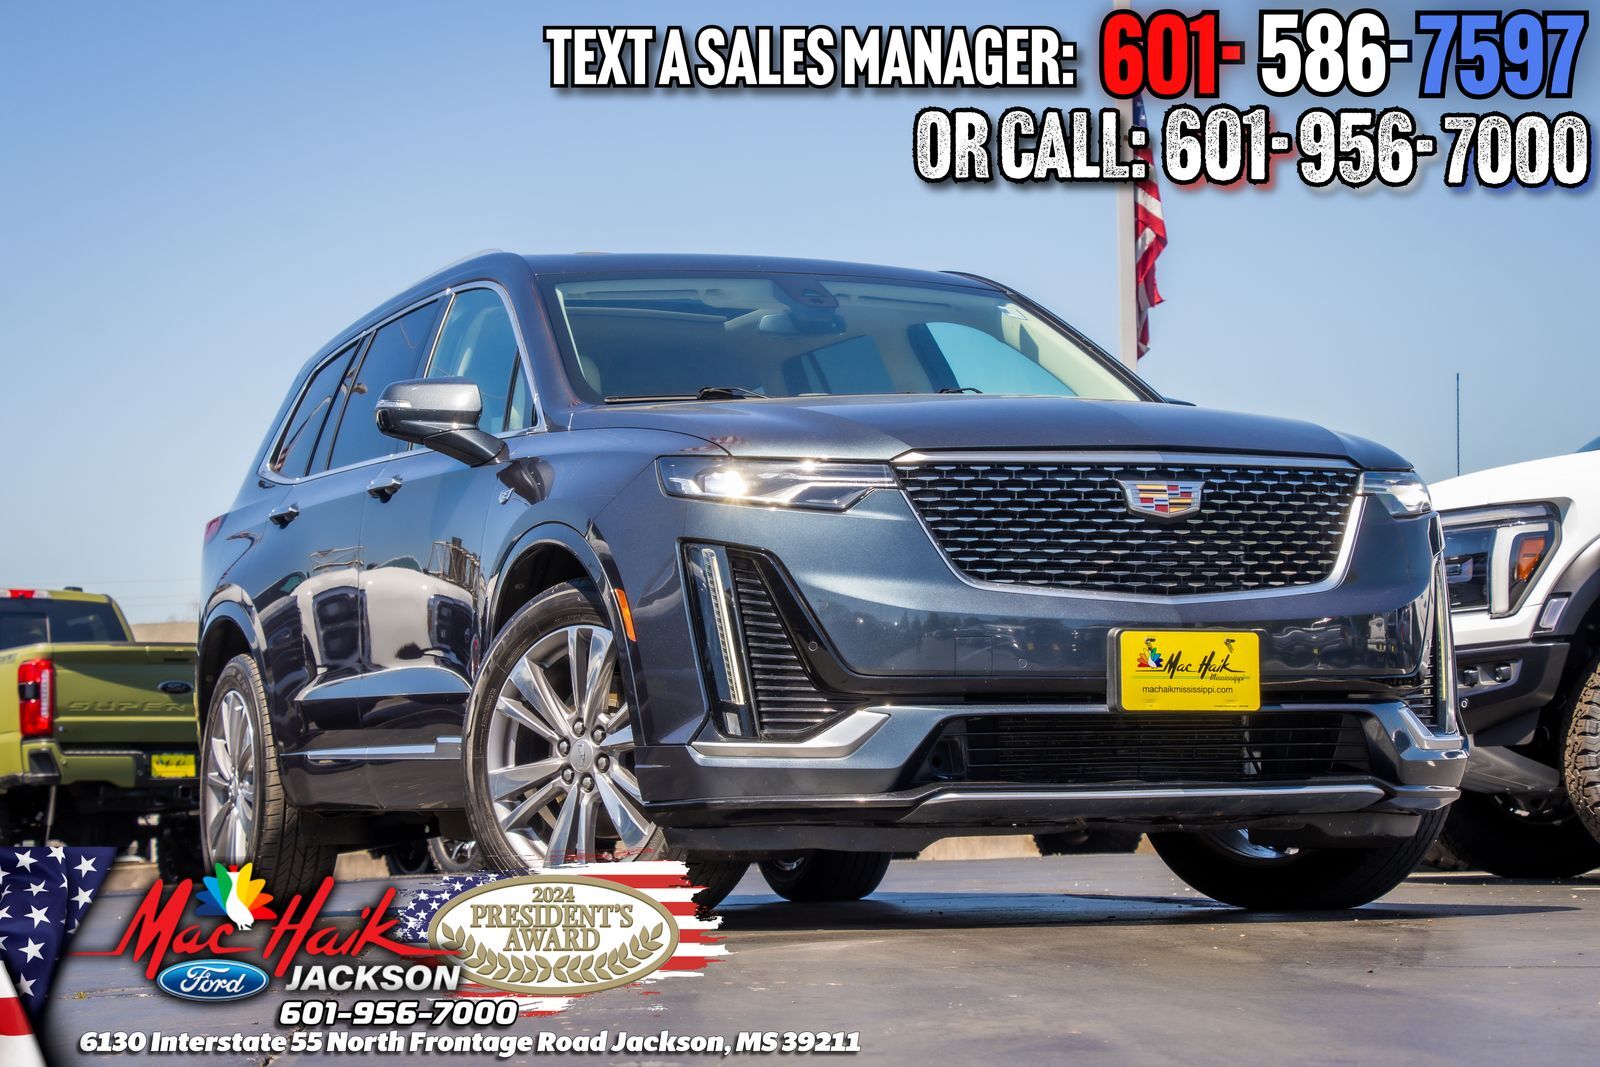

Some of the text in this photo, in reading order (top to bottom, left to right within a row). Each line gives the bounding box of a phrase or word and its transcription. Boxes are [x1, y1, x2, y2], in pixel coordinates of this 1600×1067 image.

[1158, 651, 1243, 679] Mac Haik
[1142, 685, 1234, 695] machaikmississippi.com
